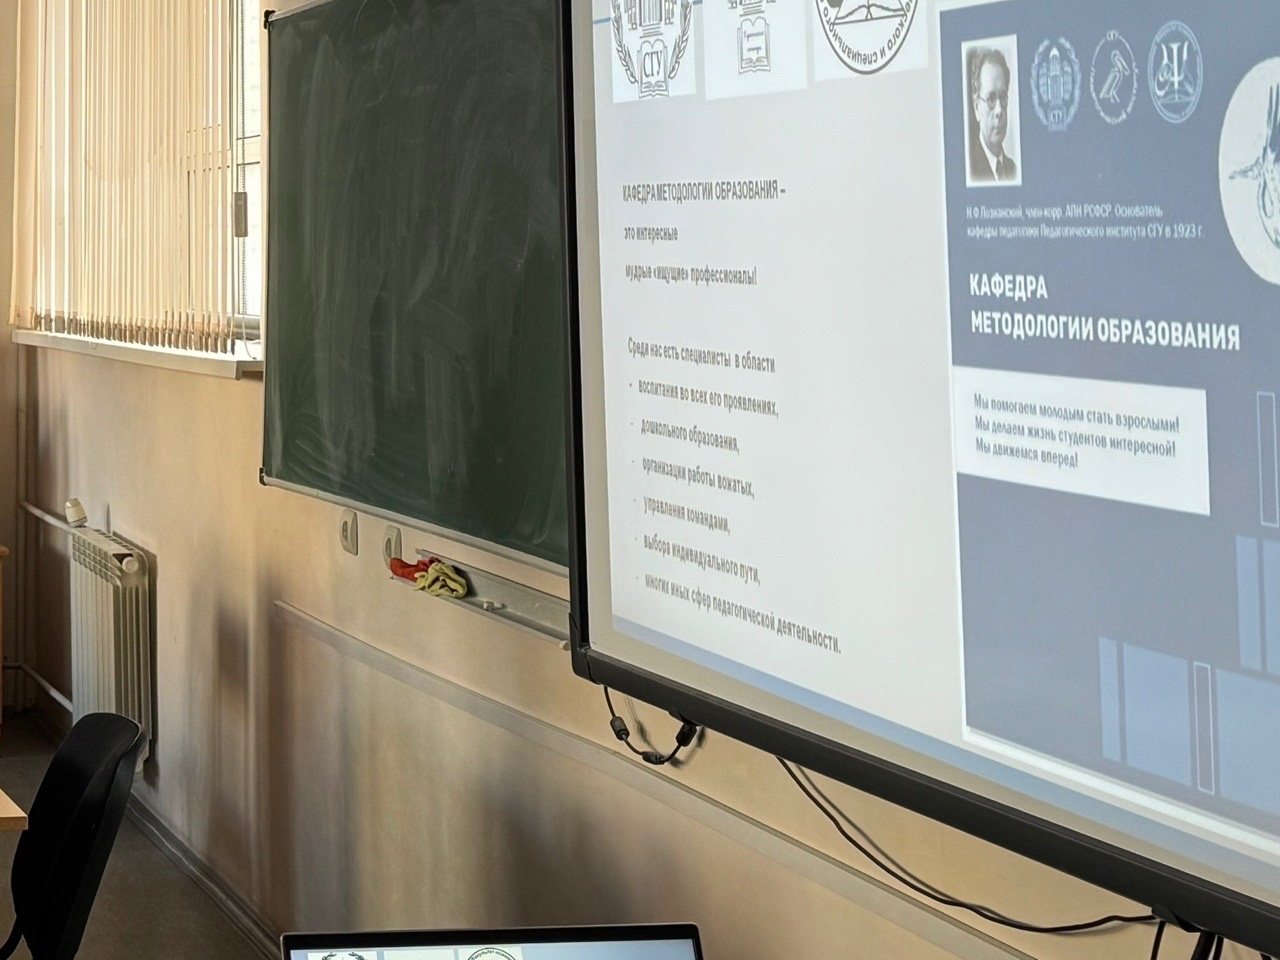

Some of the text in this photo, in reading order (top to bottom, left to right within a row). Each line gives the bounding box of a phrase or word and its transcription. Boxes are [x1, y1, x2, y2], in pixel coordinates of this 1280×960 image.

[823, 6, 878, 65] специального
[643, 50, 663, 78] СГУ
[622, 183, 656, 204] КАФЕДРА
[656, 181, 713, 204] МЕТОДОЛОГИИ
[715, 179, 778, 200] ОБРАЗОВАНИЯ
[1115, 204, 1163, 218] Основатель
[624, 227, 678, 245] это интересные
[1106, 226, 1145, 241] института
[1147, 223, 1164, 238] СГУ
[1165, 225, 1171, 237] в
[1173, 223, 1196, 238] 1923
[625, 264, 652, 283] мудрые
[690, 264, 757, 286] профессионалы!
[969, 272, 1048, 302] КАФЕДРА
[971, 310, 1241, 351] МЕТОДОЛОГИИ ОБРАЗОВАНИЯ
[628, 336, 775, 373] Среди нас есть специалисты в области
[638, 379, 779, 420] воспитания во всех его проявлениях,
[974, 393, 1179, 434] Мы помогаем молодым стать взрослыми!
[641, 418, 740, 454] дошкольного образования,
[975, 414, 1176, 458] Мы делаем жизнь студентов интересной!
[975, 437, 1078, 469] Мы движемся вперед!
[642, 457, 755, 500] организации работы вожатых,
[643, 496, 731, 536] управления командами,
[643, 533, 761, 586] выбора индивидуального пути,
[645, 573, 841, 654] многих иных сфер педагогической деятельности.
